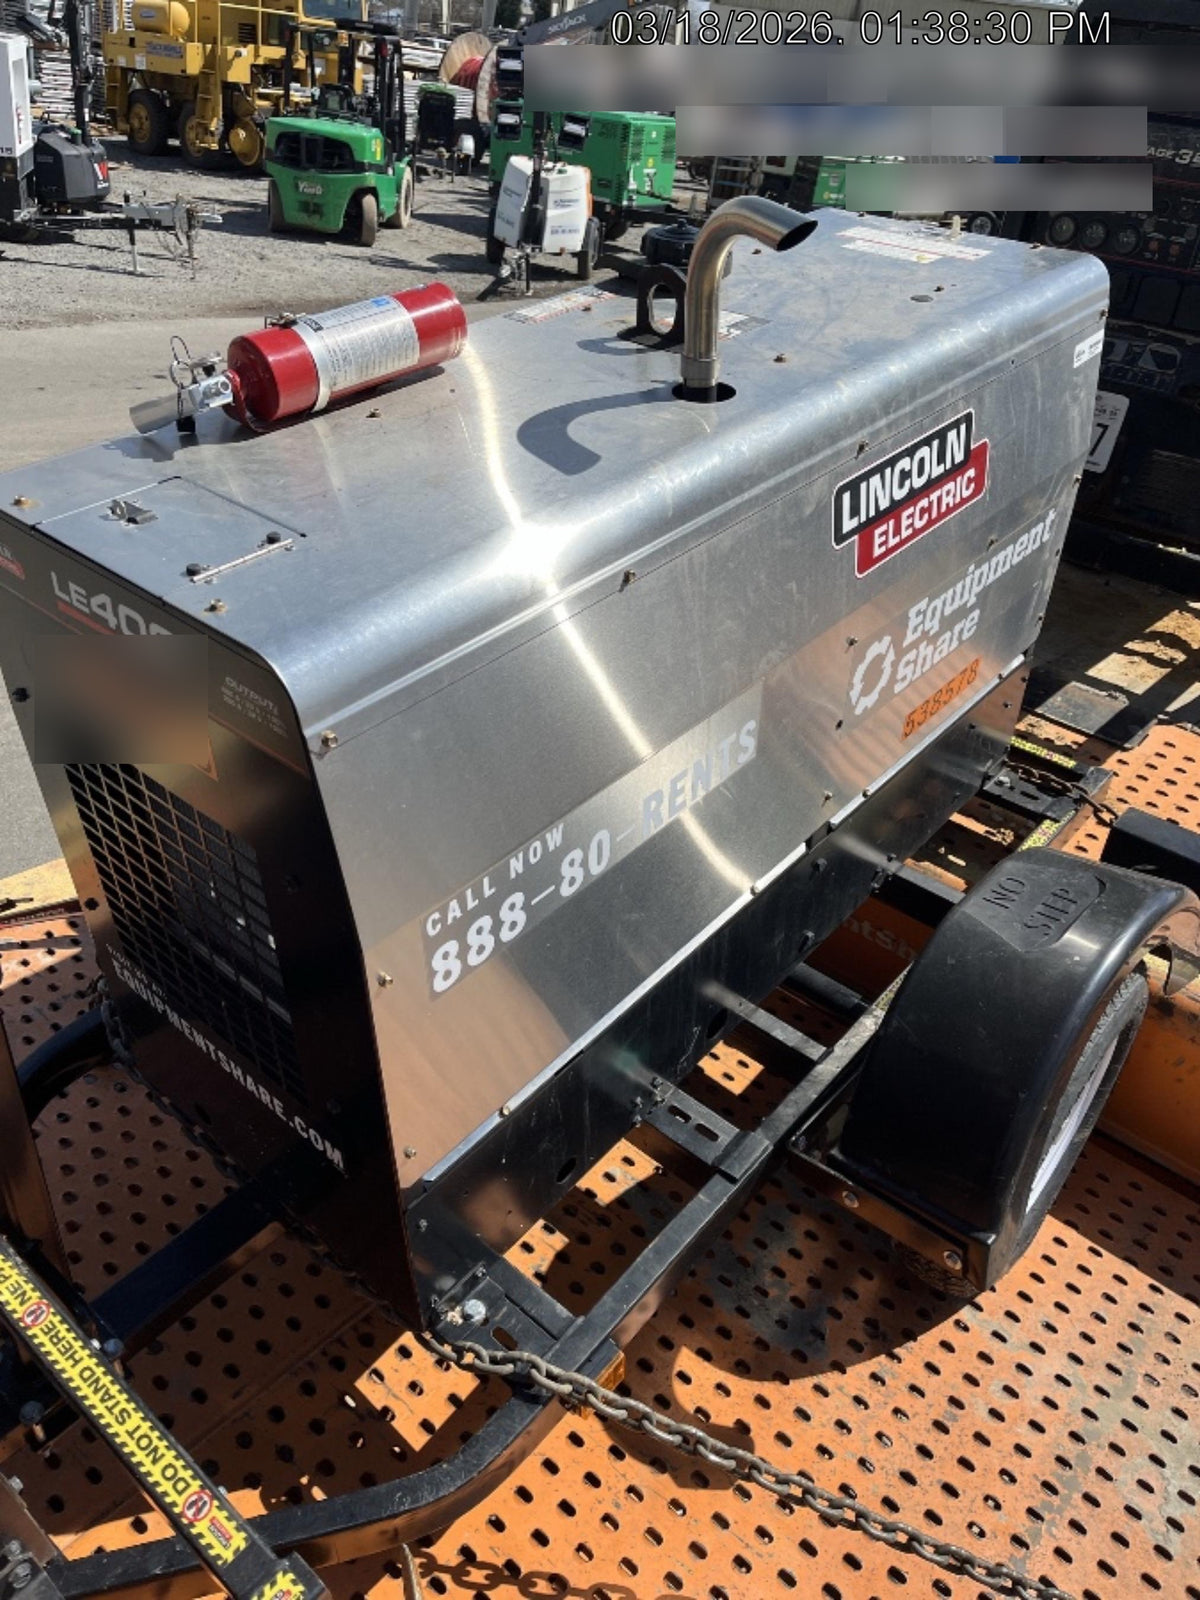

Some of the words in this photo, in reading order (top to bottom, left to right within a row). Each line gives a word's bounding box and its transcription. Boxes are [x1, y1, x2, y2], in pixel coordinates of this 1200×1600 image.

[842, 422, 967, 534] LINCOLN
[873, 468, 976, 559] ELECTRIC
[903, 507, 1057, 648] Equipment
[893, 608, 981, 695] Share
[904, 657, 980, 738] 538578
[426, 875, 496, 937] CALL
[508, 823, 564, 880] NOW
[982, 877, 1026, 910] NO
[40, 1320, 84, 1368] HERE
[80, 1366, 132, 1426] STAND
[125, 1425, 166, 1466] NOT
[160, 1462, 191, 1496] DO
